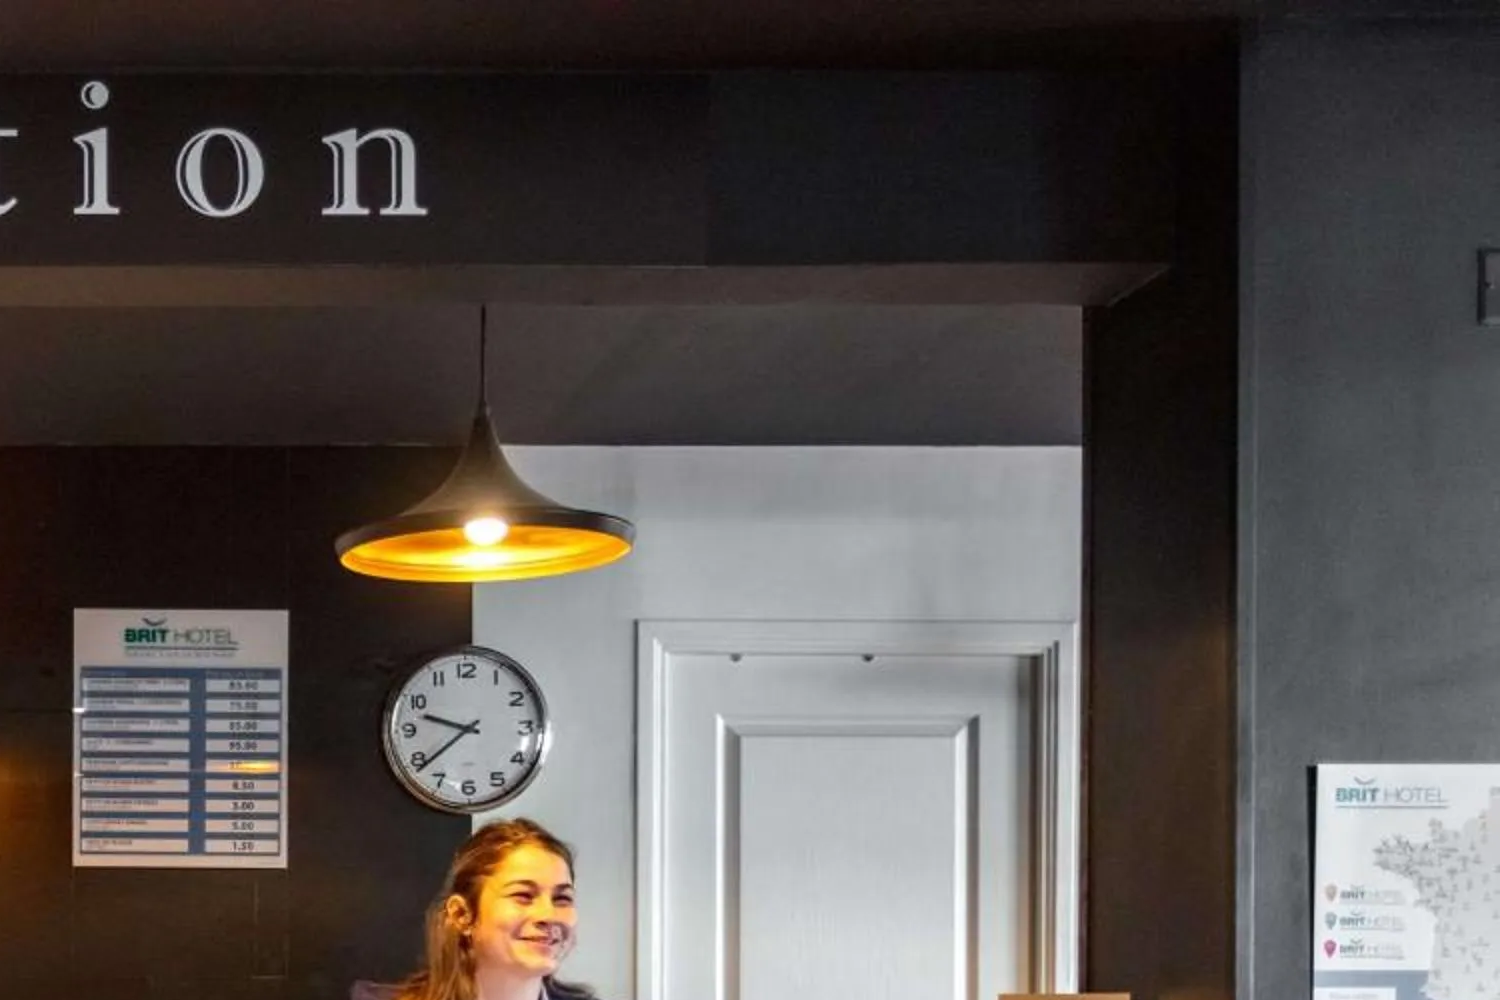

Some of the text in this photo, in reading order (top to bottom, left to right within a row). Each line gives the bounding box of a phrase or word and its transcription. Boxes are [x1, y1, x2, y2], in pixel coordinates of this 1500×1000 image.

[124, 628, 238, 645] BRIT HOTEL
[433, 671, 444, 686] 11
[457, 663, 476, 679] 12
[411, 694, 426, 709] 10
[509, 691, 524, 707] 2
[402, 723, 416, 738] 9
[517, 720, 533, 735] 3
[411, 751, 426, 767] 8
[510, 751, 525, 765] 4
[432, 773, 446, 788] 7
[490, 771, 505, 787] 5
[461, 780, 476, 795] 6
[1335, 787, 1448, 802] BRIT HOTEL
